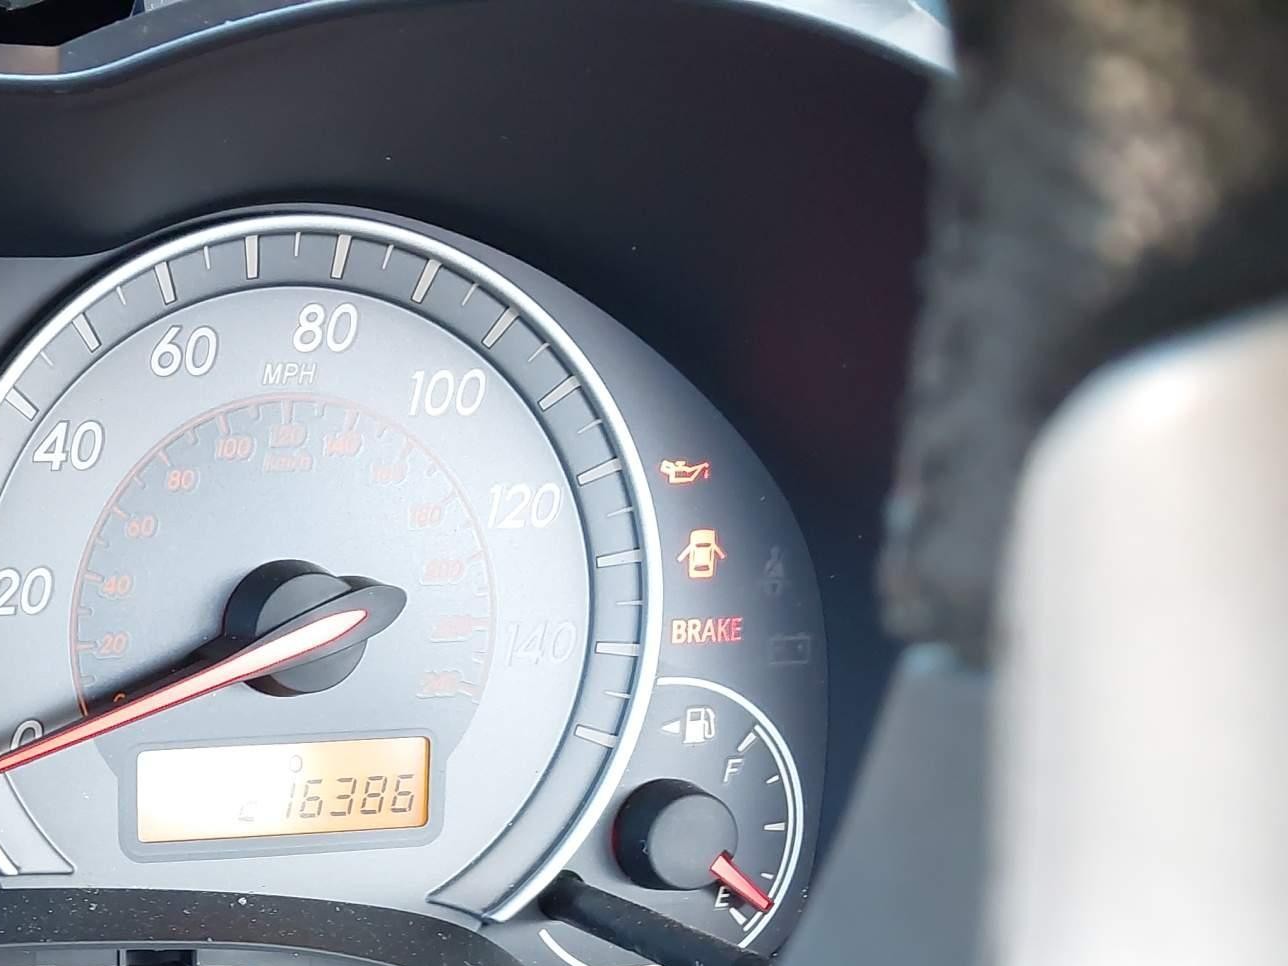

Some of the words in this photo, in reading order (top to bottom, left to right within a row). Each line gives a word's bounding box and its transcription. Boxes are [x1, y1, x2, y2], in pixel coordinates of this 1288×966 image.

[292, 301, 359, 353] 80
[149, 324, 218, 377] 60
[262, 362, 317, 386] MPH
[408, 368, 487, 418] 100
[31, 419, 106, 472] 40
[216, 436, 253, 459] 100
[166, 469, 197, 491] 80
[487, 481, 564, 529] 120
[126, 514, 158, 537] 60
[101, 575, 132, 596] 40
[671, 616, 743, 644] BRAKE
[99, 632, 129, 655] 20
[723, 757, 744, 783] F
[714, 886, 731, 909] E
